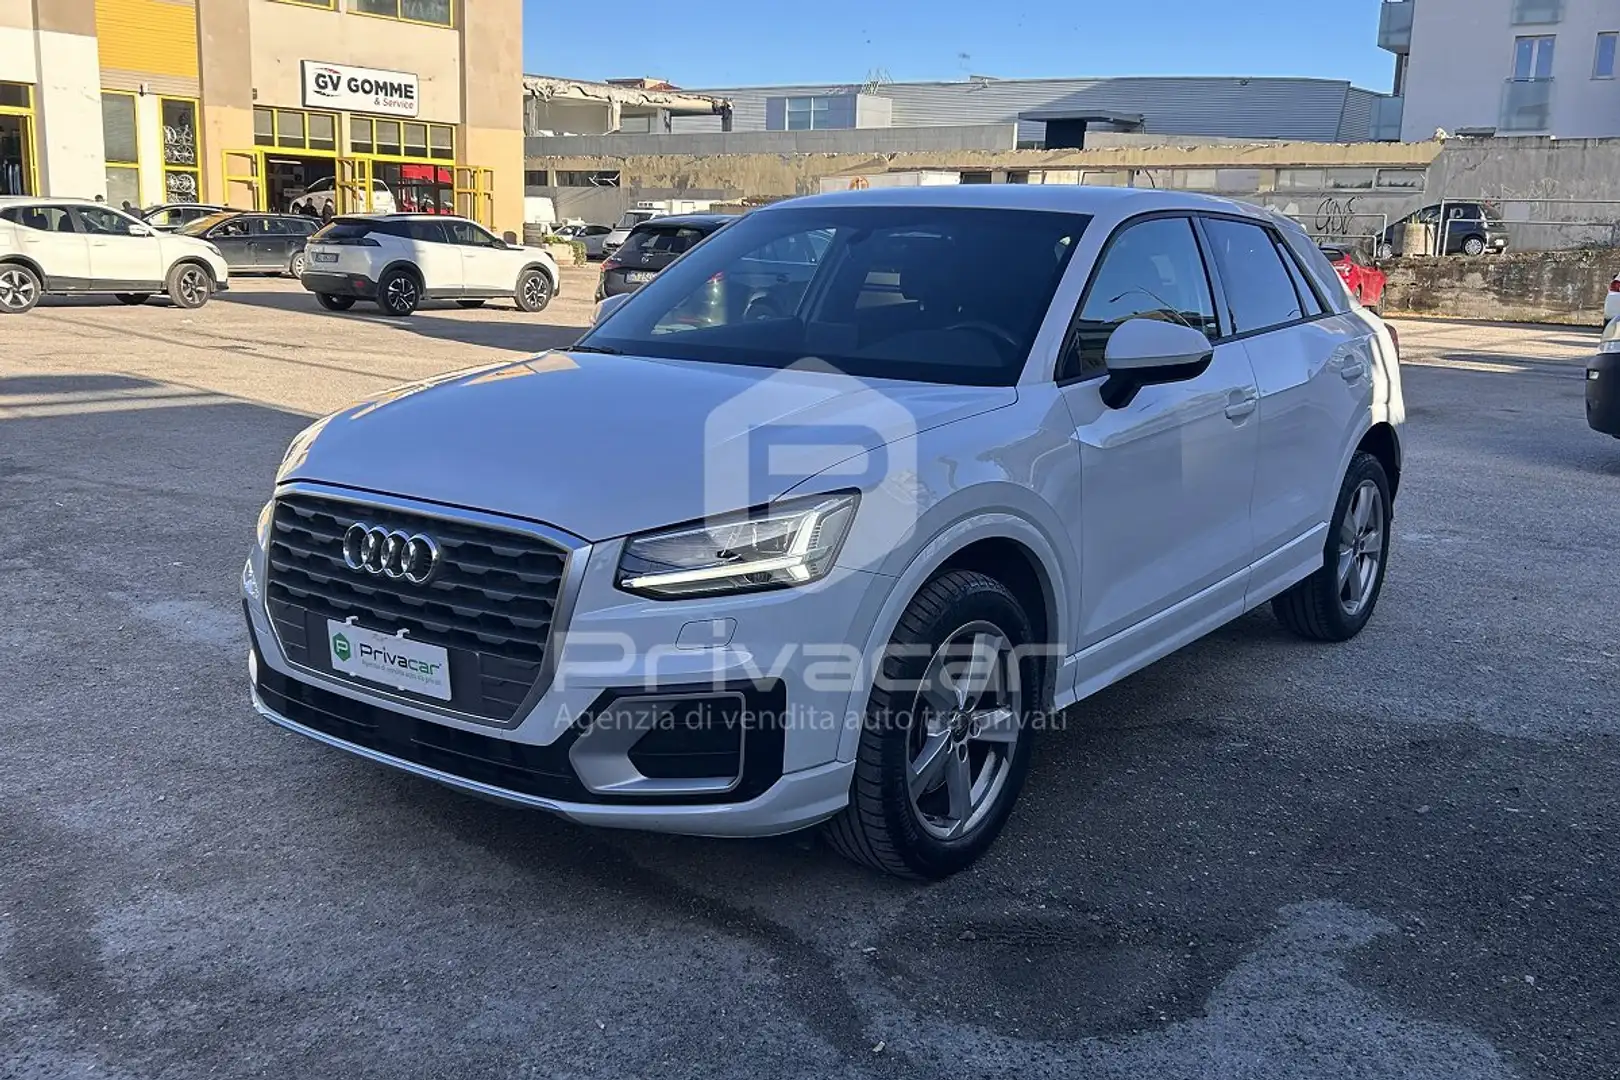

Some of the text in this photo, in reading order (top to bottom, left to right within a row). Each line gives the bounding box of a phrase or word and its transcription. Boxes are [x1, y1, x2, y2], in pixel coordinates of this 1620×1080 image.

[314, 73, 415, 99] GV GOMME
[373, 98, 414, 110] & Service
[359, 643, 441, 675] Privacar
